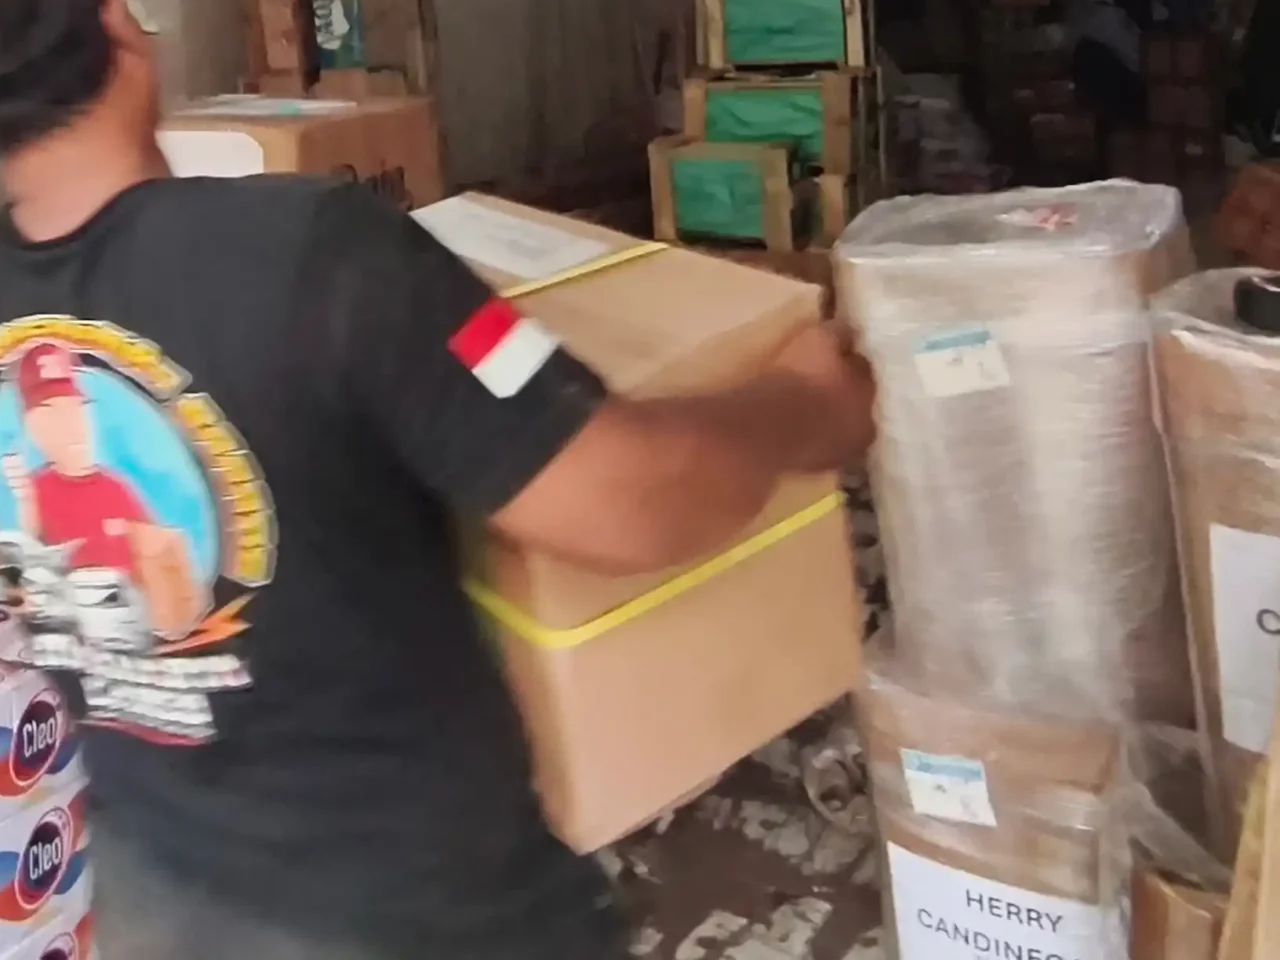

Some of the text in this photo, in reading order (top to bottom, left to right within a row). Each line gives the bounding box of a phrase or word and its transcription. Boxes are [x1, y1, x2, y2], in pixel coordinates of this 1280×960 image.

[22, 718, 57, 758] Cleo
[28, 836, 62, 881] Cleo
[966, 889, 1064, 933] HERRY
